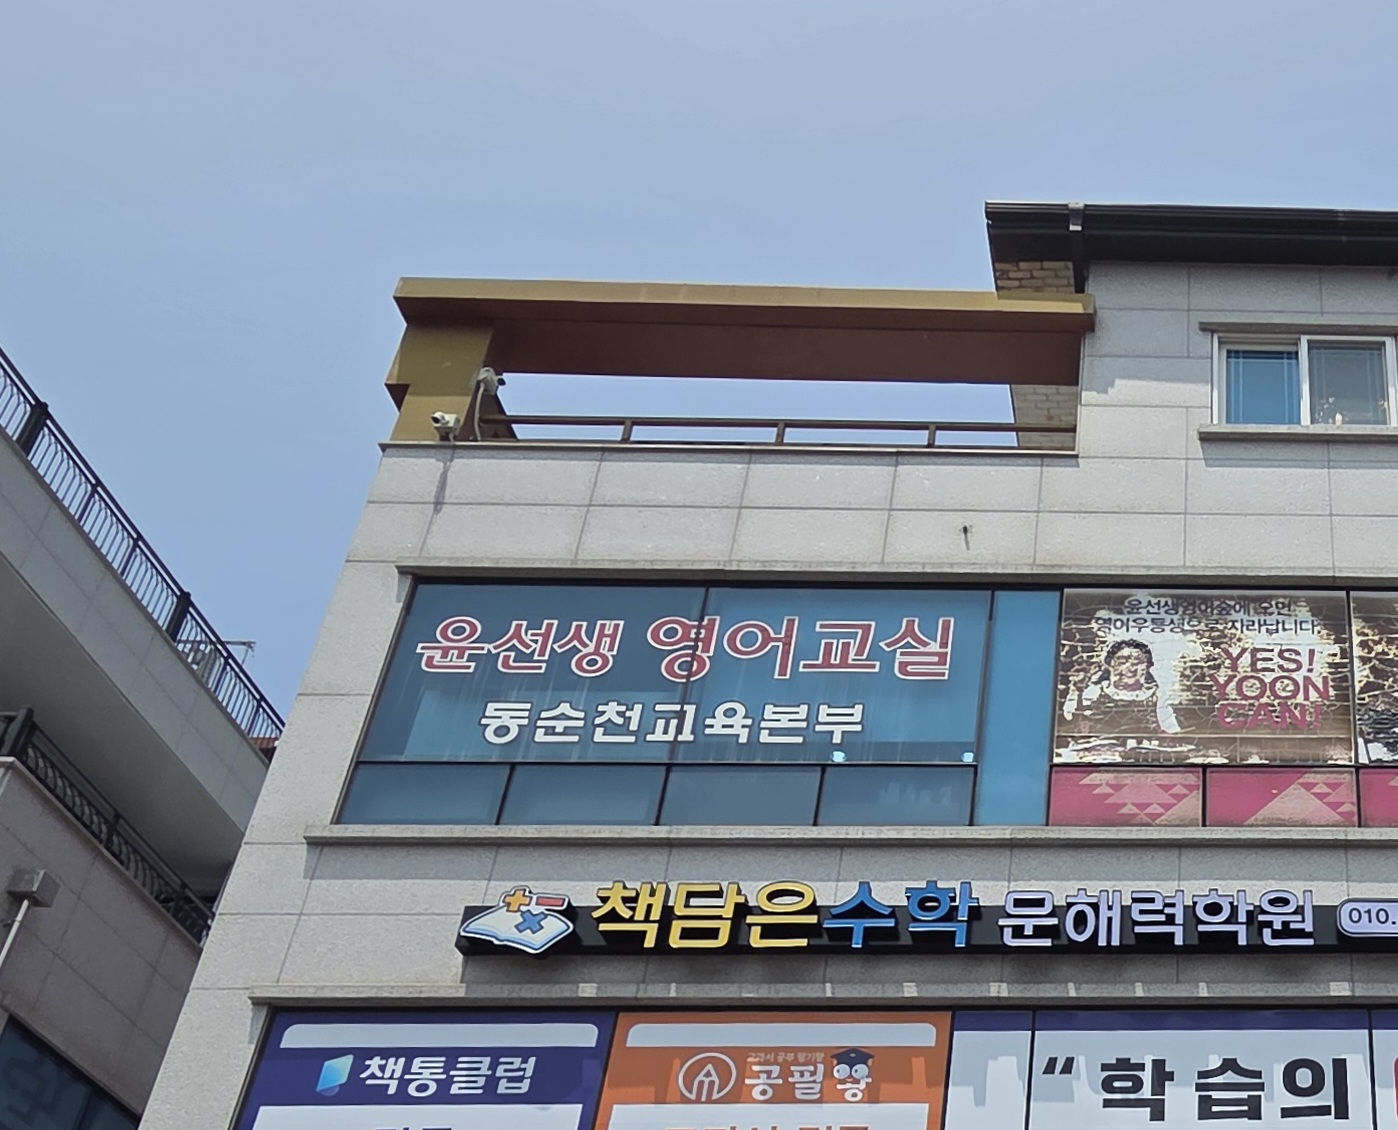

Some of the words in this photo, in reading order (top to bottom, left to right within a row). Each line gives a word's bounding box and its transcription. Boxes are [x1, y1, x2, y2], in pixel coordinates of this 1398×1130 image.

[415, 615, 624, 678] 윤선생
[646, 615, 955, 681] 영어교실
[1220, 647, 1316, 673] YES!
[1208, 674, 1331, 701] YOON
[479, 701, 864, 745] 동순천교육본부
[1216, 701, 1324, 730] CAN!
[997, 888, 1314, 948] 문해력학원
[359, 1056, 537, 1097] 책통클럽
